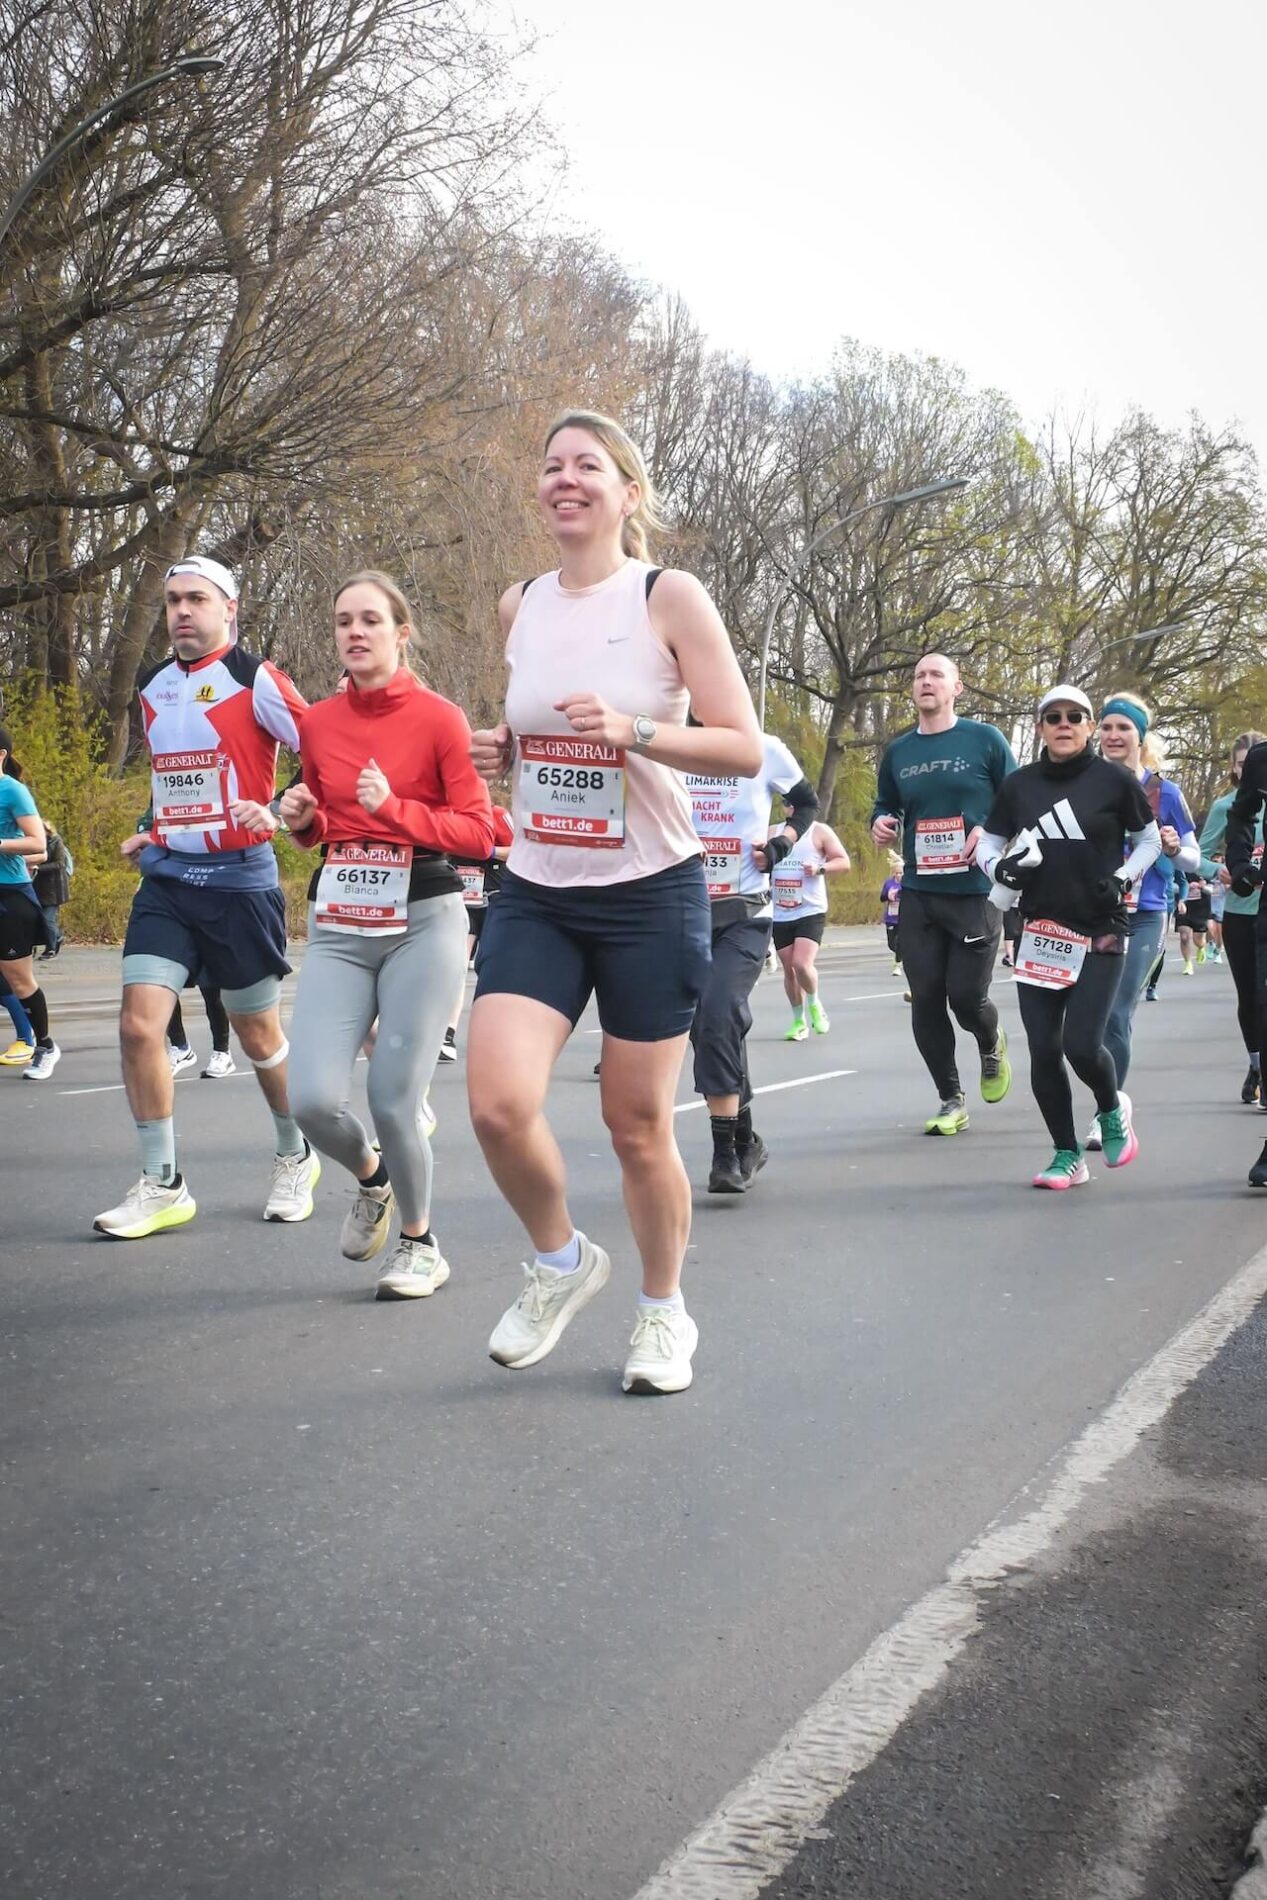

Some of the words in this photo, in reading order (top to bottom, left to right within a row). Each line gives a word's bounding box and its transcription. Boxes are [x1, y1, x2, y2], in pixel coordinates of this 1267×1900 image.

[545, 741, 617, 760] GENERALI
[165, 753, 213, 768] GENERALI
[900, 760, 952, 778] CRAFT
[163, 773, 204, 788] 19846
[537, 767, 604, 790] 65288
[685, 775, 739, 787] LIMAKRISE
[168, 789, 200, 797] Anthony
[551, 790, 586, 804] Aniek
[168, 805, 203, 816] bett1.de
[692, 801, 721, 811] ACHT
[542, 815, 593, 831] bett1.de
[701, 812, 735, 823] KRANK
[924, 833, 954, 844] 61814
[704, 841, 737, 851] NERALI
[346, 847, 407, 863] GENERALI
[336, 868, 391, 885] 66137
[344, 884, 379, 896] Bianca
[338, 905, 384, 917] bett1.de
[1033, 936, 1073, 954] 57128
